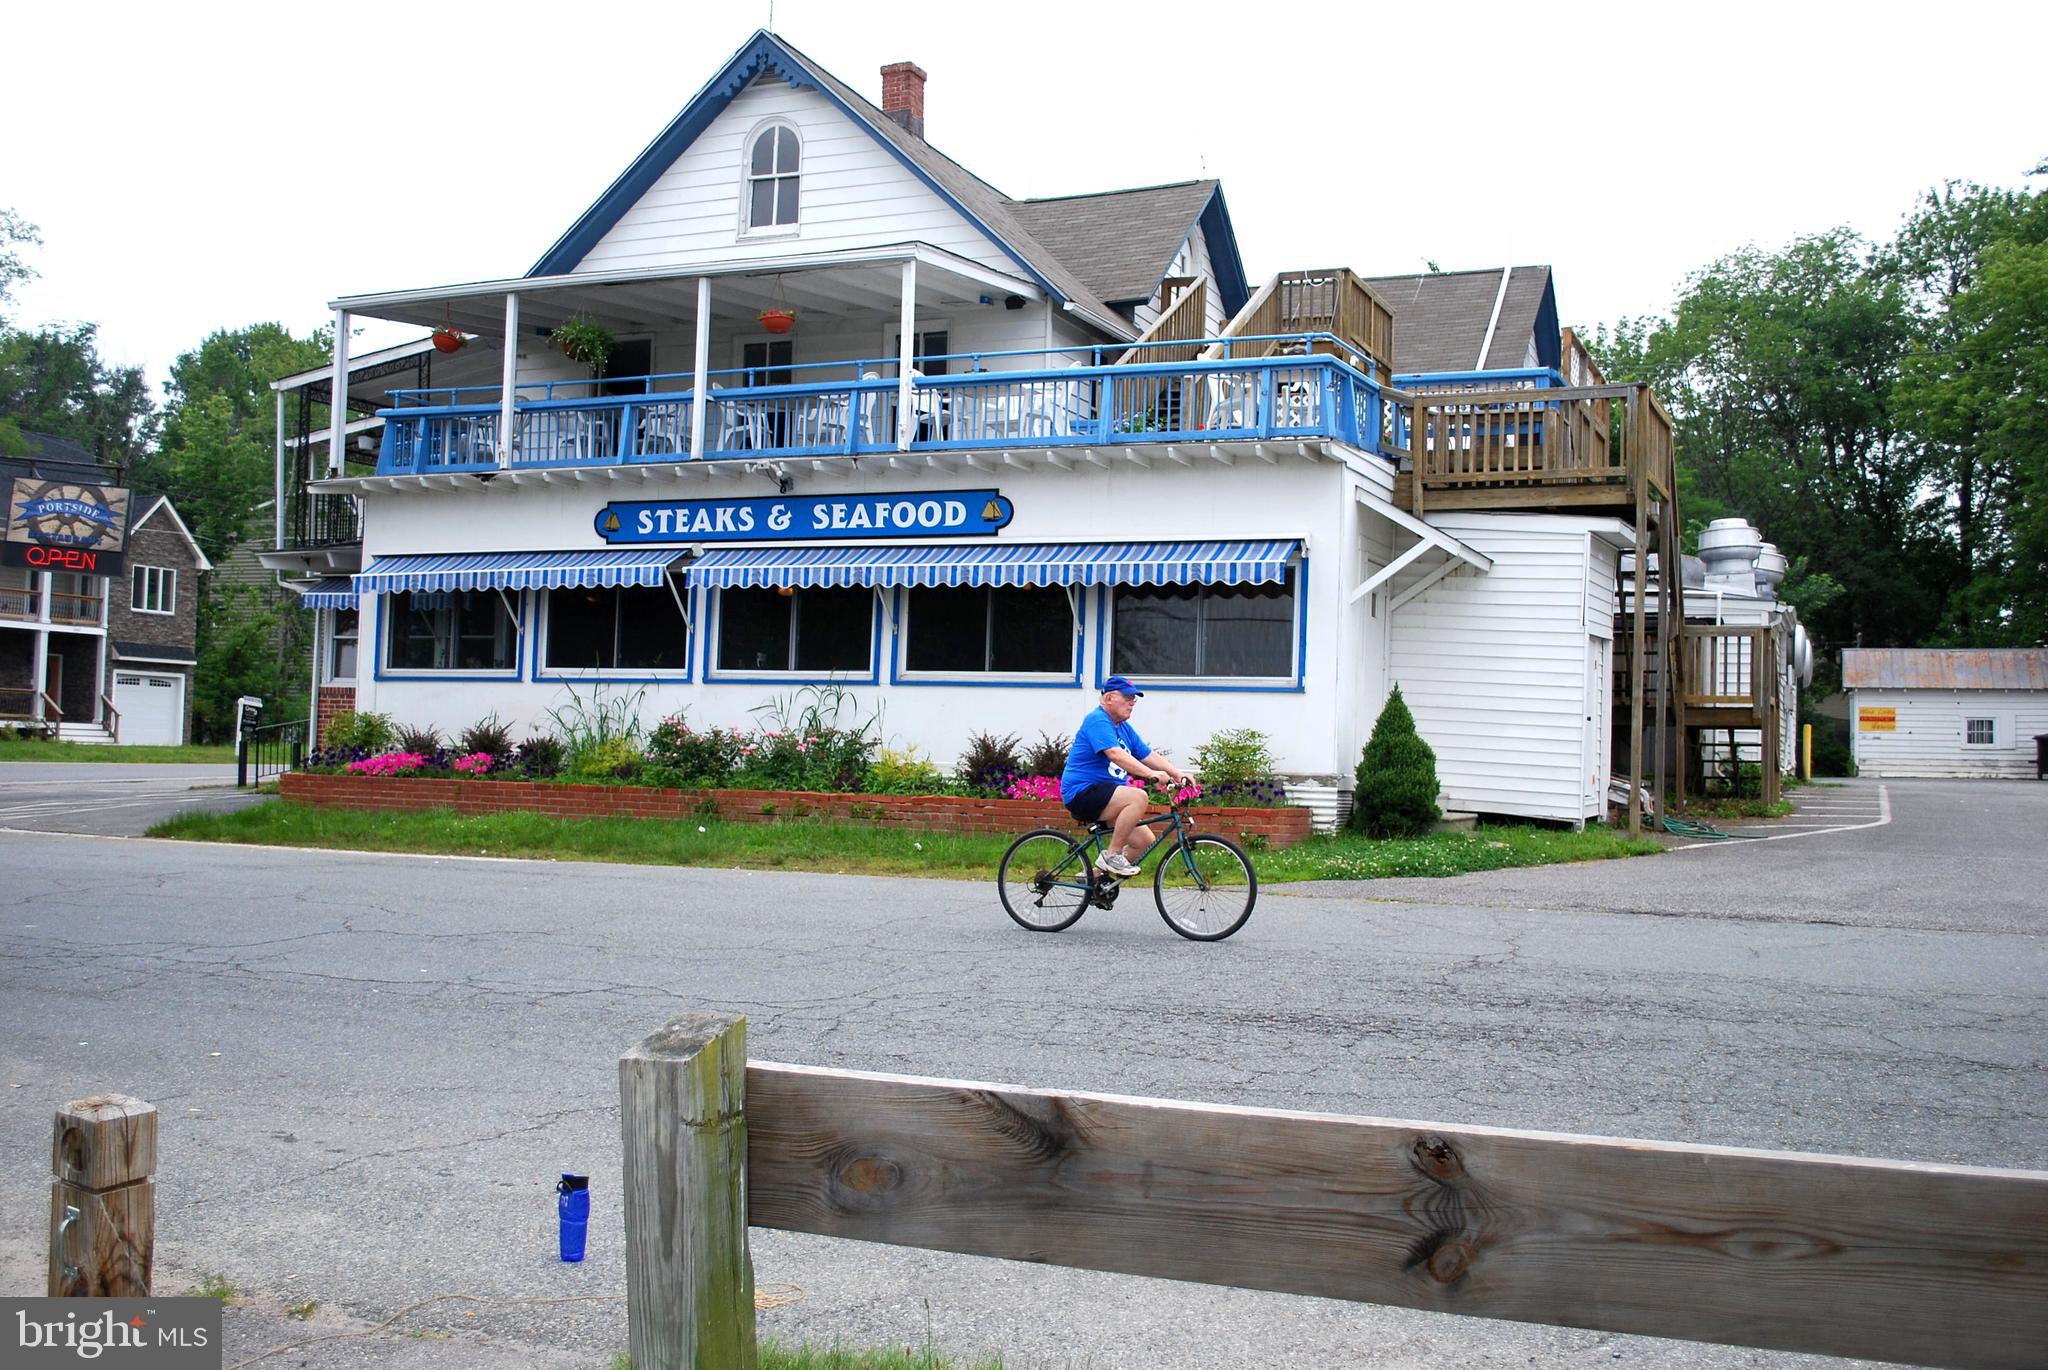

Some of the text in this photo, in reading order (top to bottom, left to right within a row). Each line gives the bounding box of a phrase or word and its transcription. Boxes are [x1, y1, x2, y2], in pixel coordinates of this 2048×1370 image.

[38, 502, 100, 518] PORTSIDE
[637, 501, 967, 535] STEAKS & SEAFOOD
[26, 546, 97, 571] OPEN
